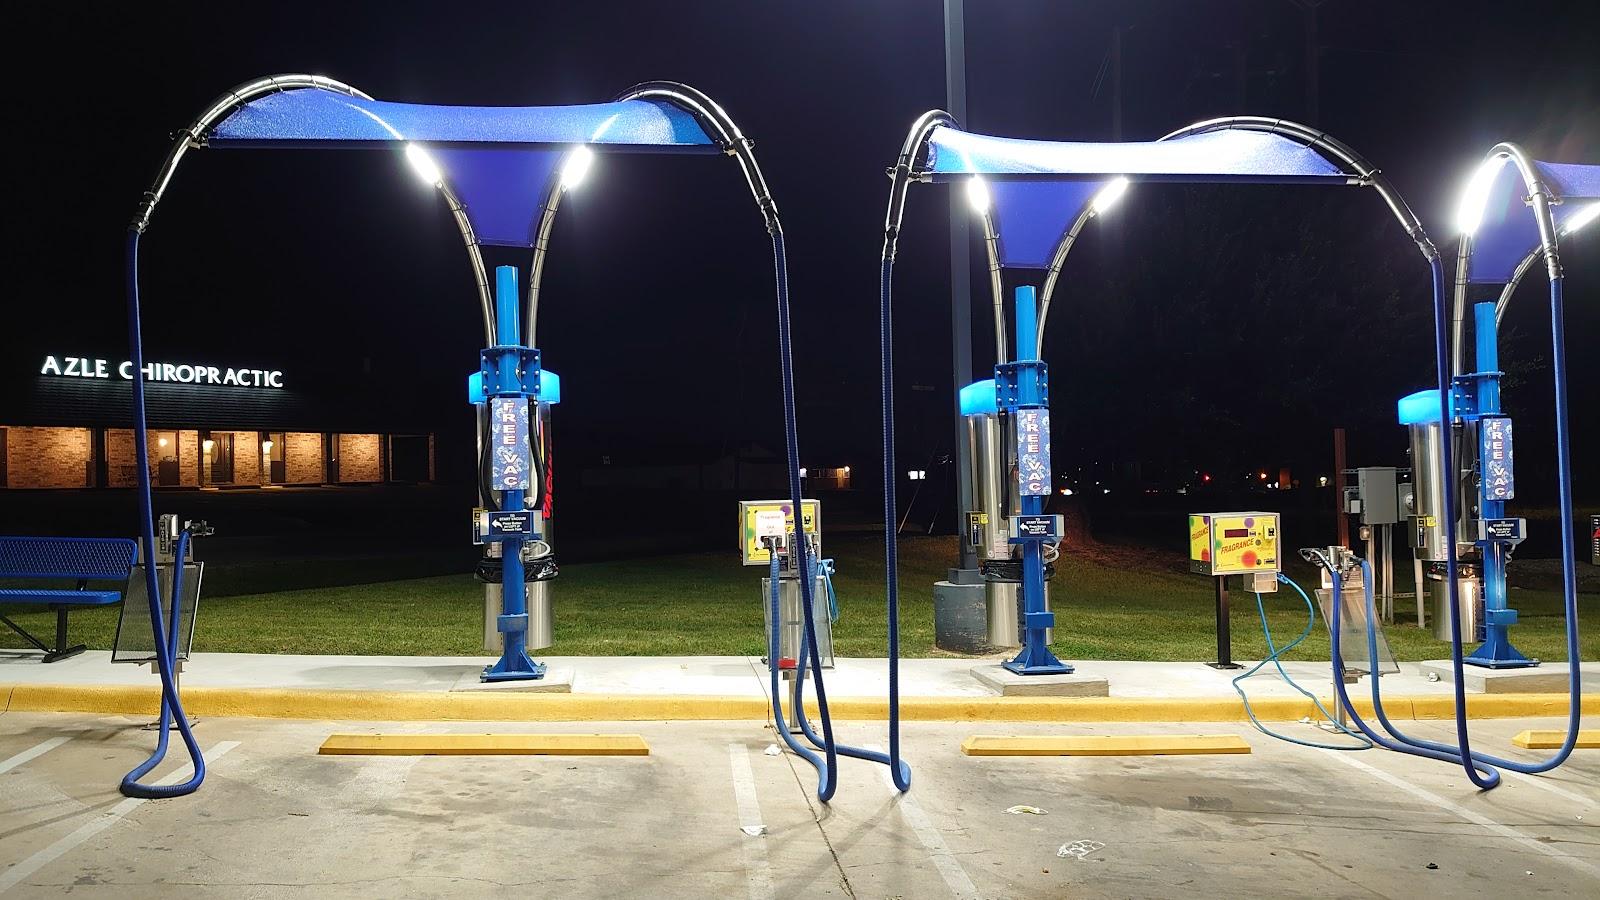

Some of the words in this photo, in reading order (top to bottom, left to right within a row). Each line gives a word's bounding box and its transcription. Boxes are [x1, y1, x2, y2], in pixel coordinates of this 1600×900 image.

[41, 356, 109, 378] AZLE
[119, 361, 283, 387] CHIROPRACTIC
[502, 402, 517, 445] FREE
[1026, 413, 1039, 453] FREE
[1492, 421, 1503, 460] FREE
[503, 454, 518, 487] VAC
[1028, 462, 1042, 491] VAC
[1494, 468, 1506, 497] VAC
[1221, 538, 1254, 554] FRAGRANCE
